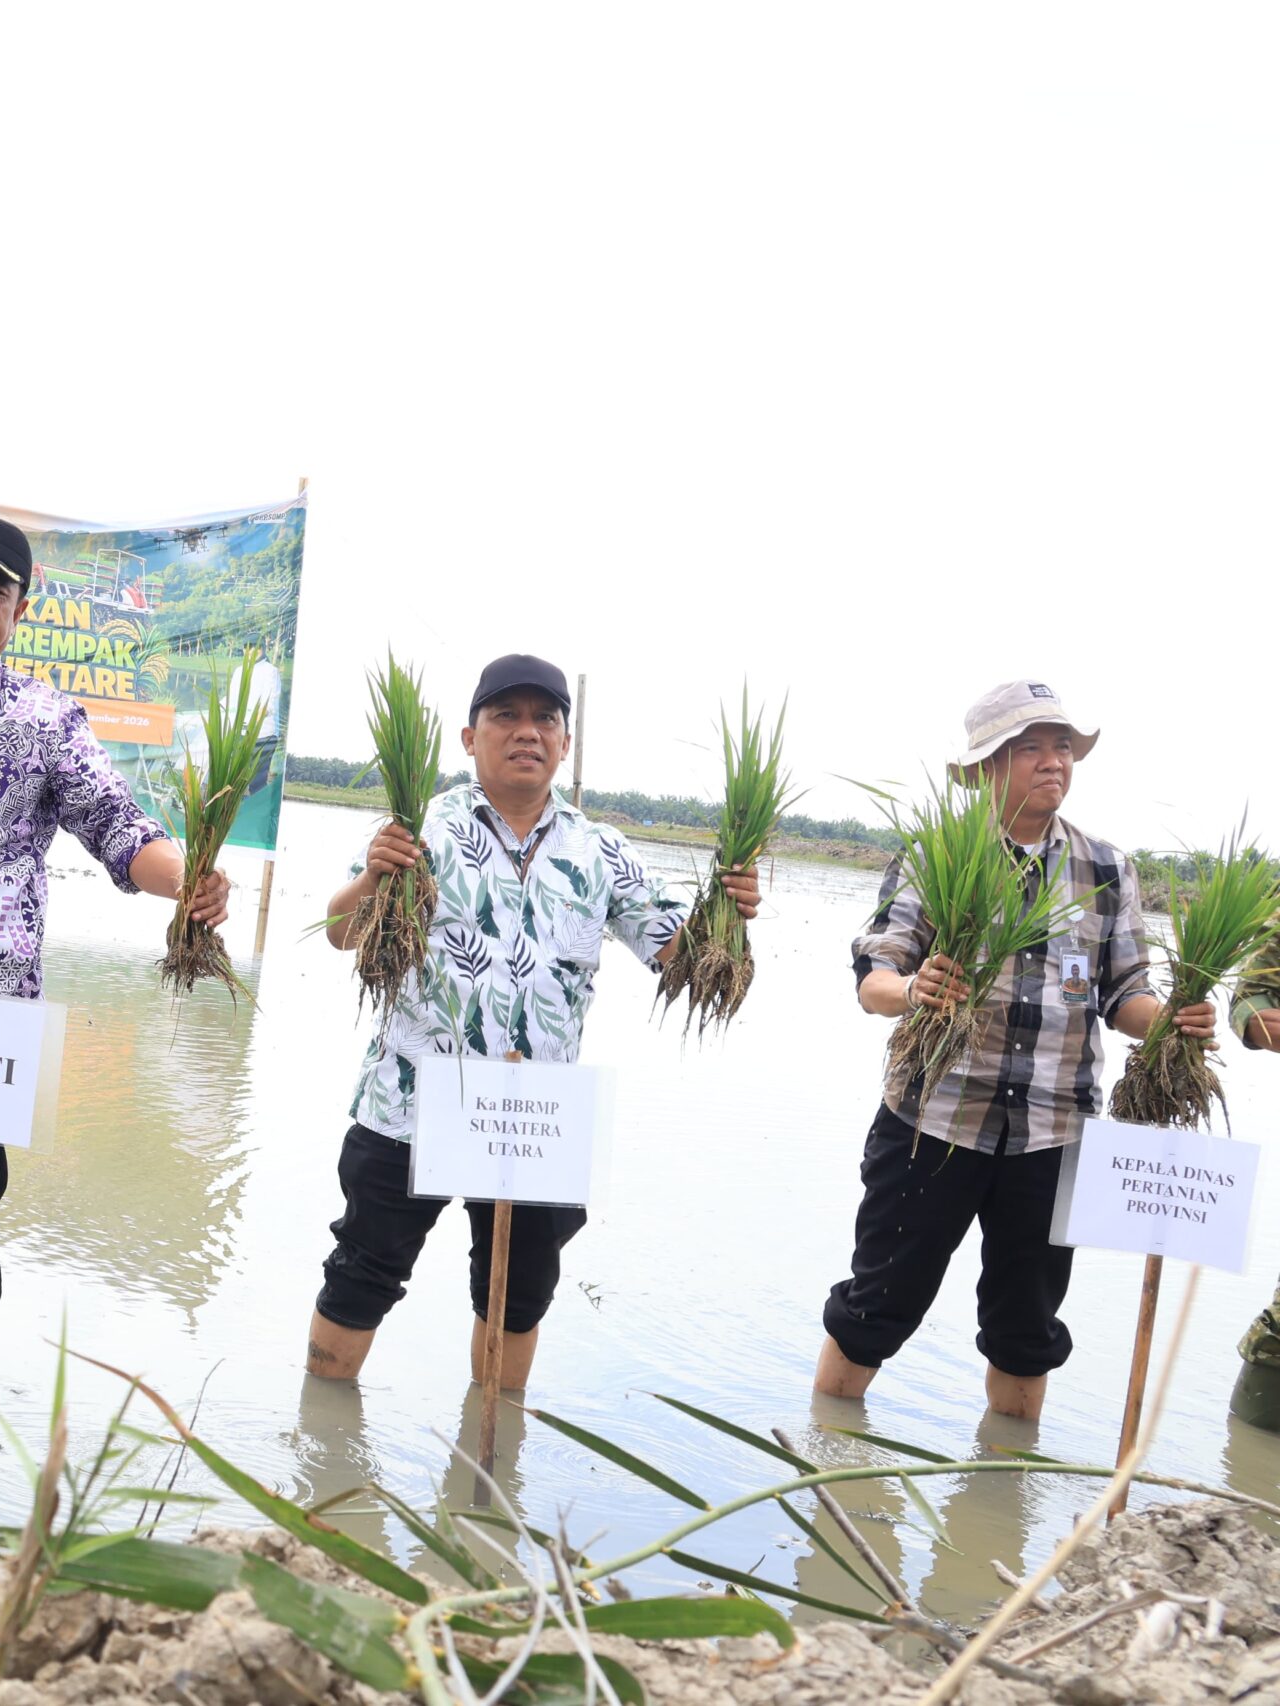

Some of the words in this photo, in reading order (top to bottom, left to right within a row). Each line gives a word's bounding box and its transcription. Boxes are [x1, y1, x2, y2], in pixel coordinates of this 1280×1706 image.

[20, 594, 91, 630] KAN
[5, 624, 137, 670] REMPAK
[123, 716, 150, 726] 2026
[476, 1097, 496, 1111] Ka
[502, 1098, 560, 1115] BBRMP
[469, 1118, 562, 1137] SUMATERA
[488, 1142, 544, 1158] UTARA
[1112, 1156, 1178, 1177] KEPALA
[1184, 1166, 1235, 1188] DINAS
[1121, 1179, 1219, 1205] PERTANIAN
[1127, 1200, 1208, 1224] PROVINSI
